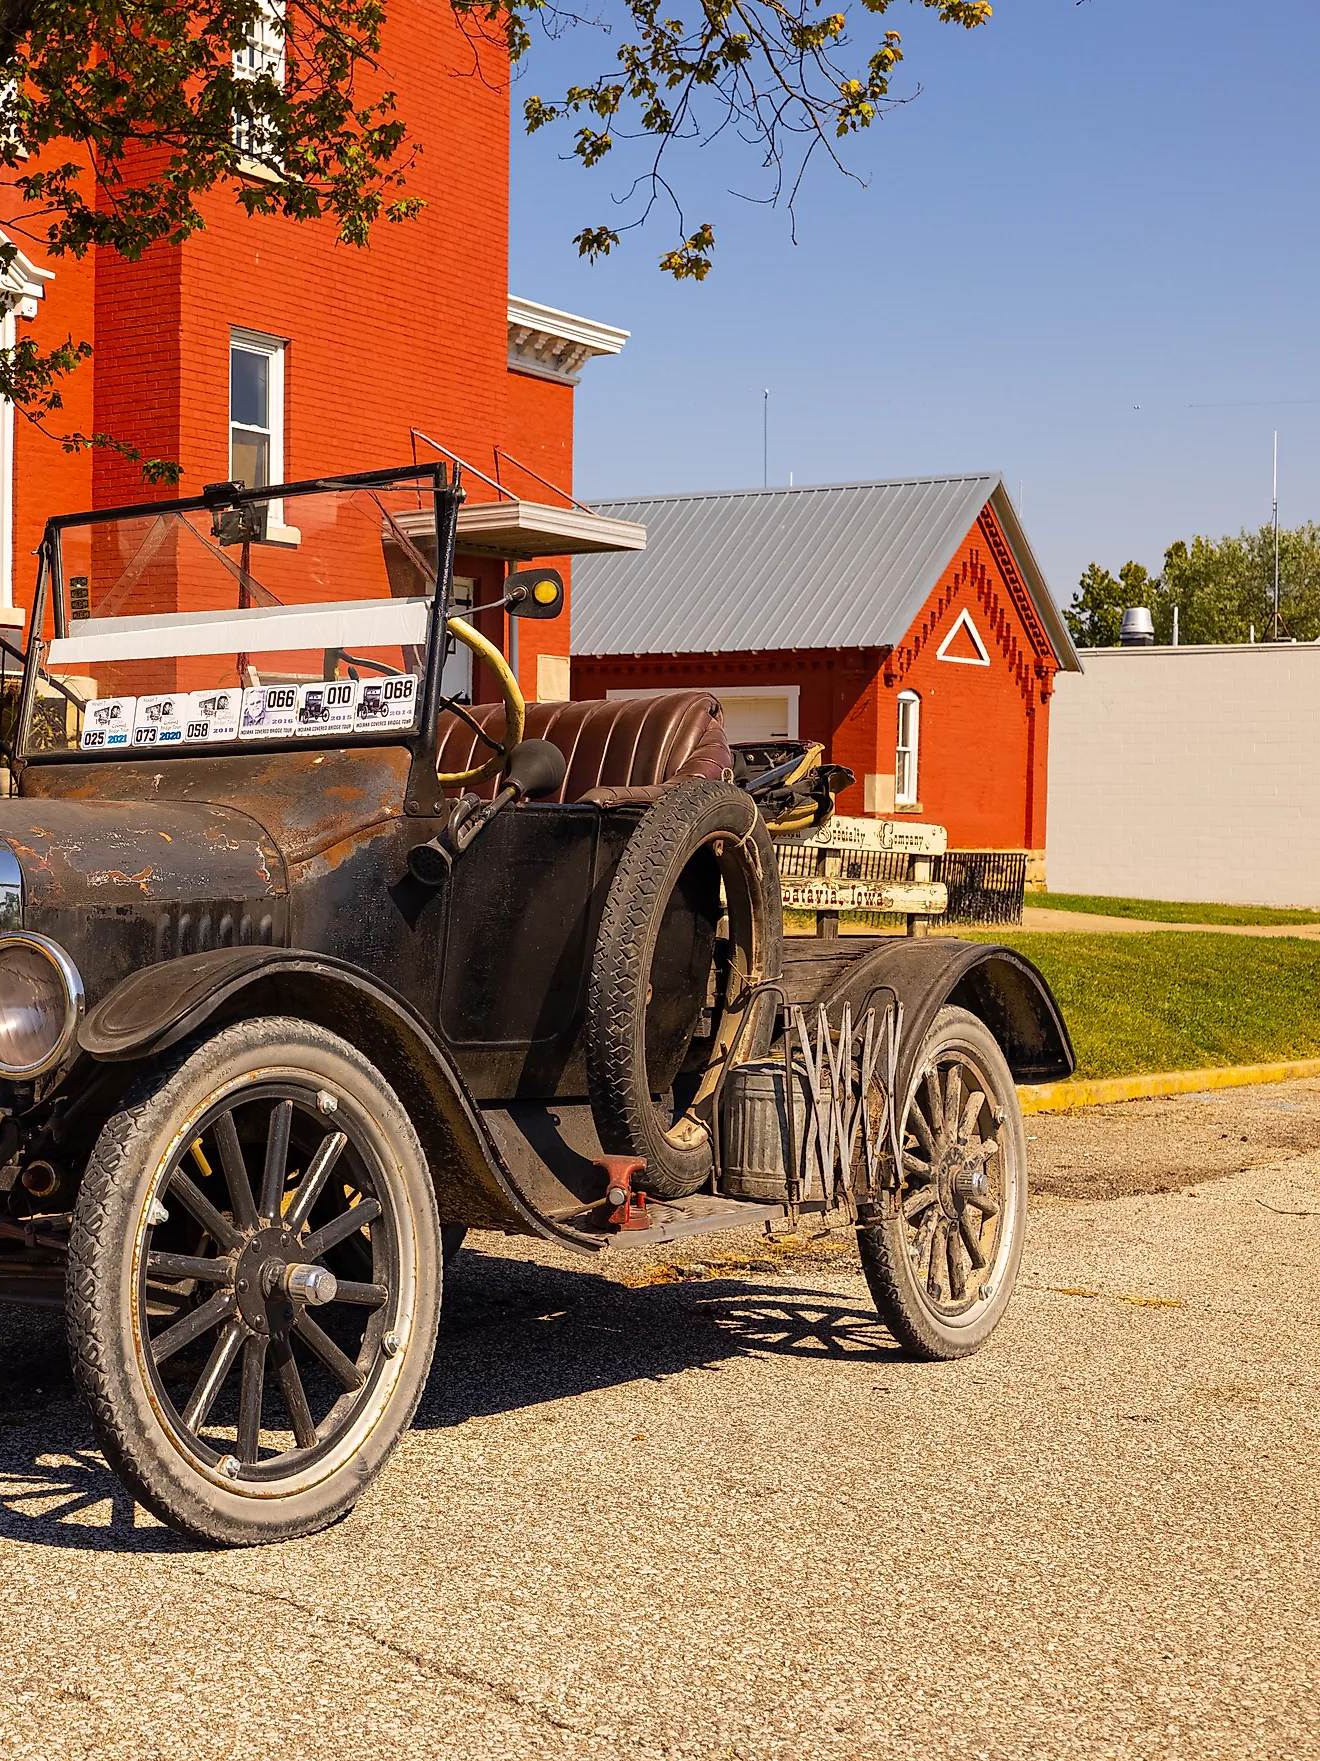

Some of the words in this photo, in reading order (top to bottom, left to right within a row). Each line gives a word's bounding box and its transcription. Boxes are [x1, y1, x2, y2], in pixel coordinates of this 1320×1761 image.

[327, 685, 351, 704] 010
[384, 680, 413, 699] 068
[267, 690, 295, 708] 066
[84, 732, 105, 746] 025
[107, 734, 128, 744] 2021
[135, 729, 156, 743] 073
[159, 731, 182, 741] 2020
[187, 723, 209, 738] 058
[815, 821, 866, 849] Specialty
[879, 823, 924, 851] Company
[850, 884, 884, 905] Iowa
